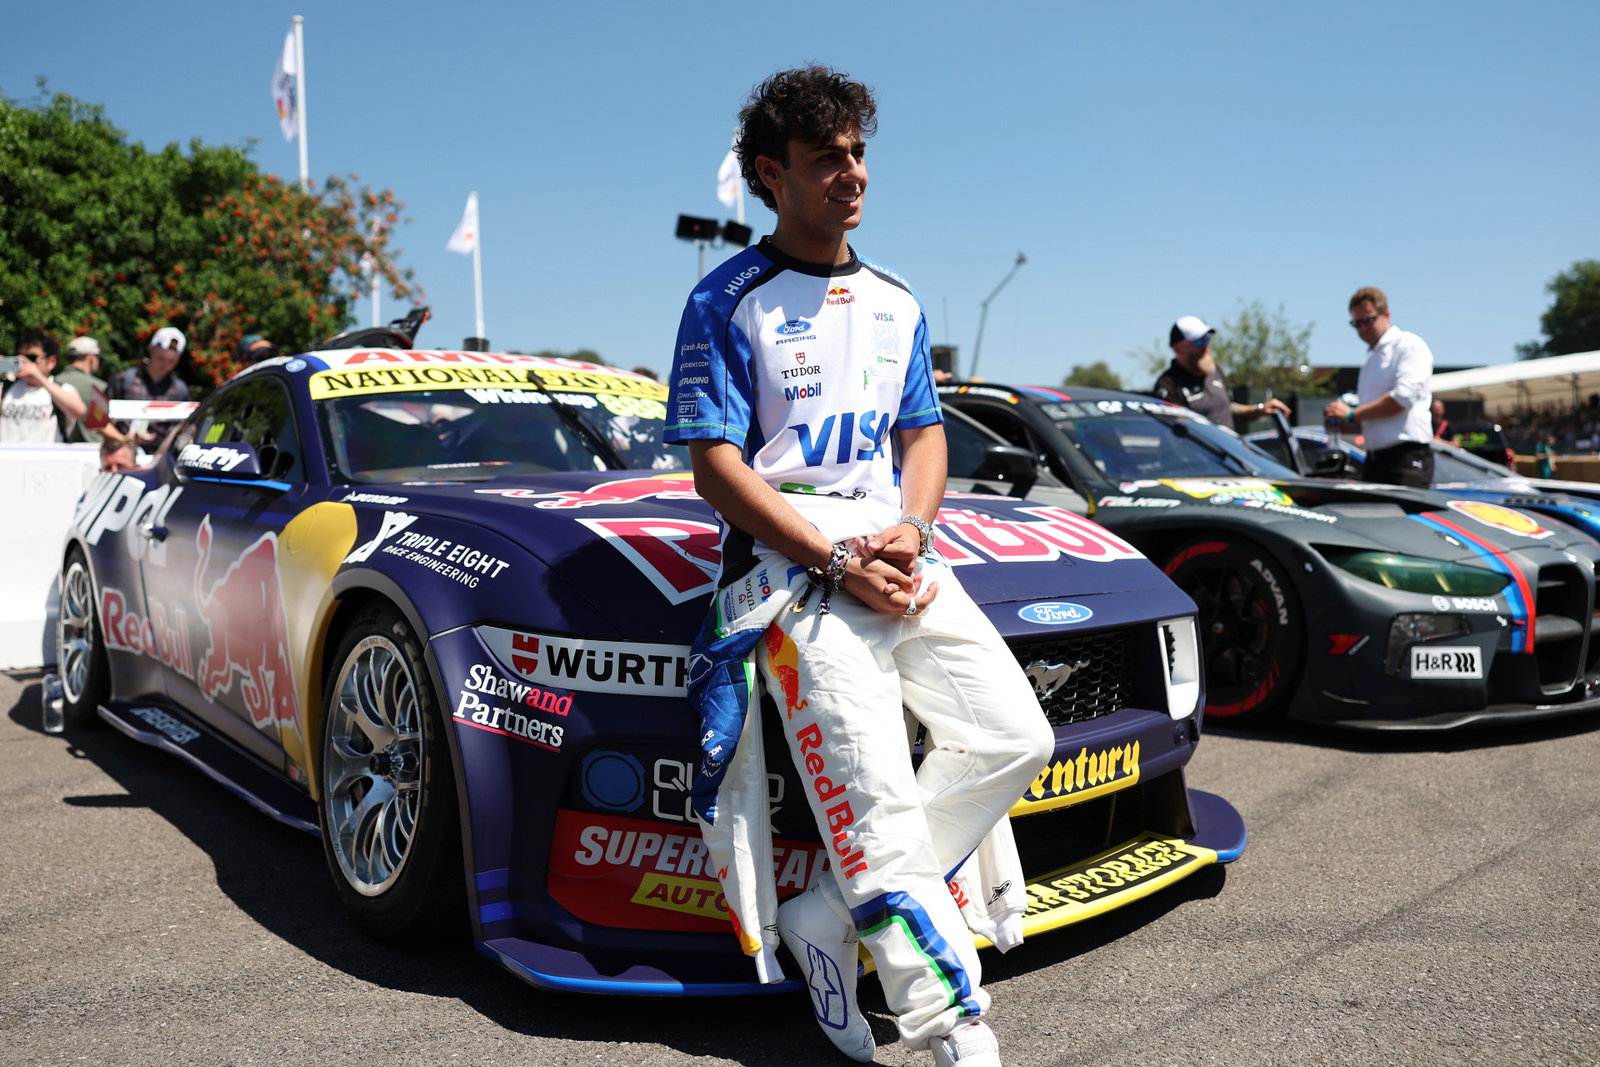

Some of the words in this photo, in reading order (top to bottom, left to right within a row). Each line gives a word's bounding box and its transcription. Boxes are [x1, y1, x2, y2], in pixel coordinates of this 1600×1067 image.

[724, 264, 761, 297] HUGO
[826, 297, 842, 306] Red
[841, 294, 855, 305] Bull
[873, 311, 895, 323] VISA
[696, 342, 709, 351] App
[775, 334, 817, 346] RACING
[322, 365, 530, 391] NATIONAL
[781, 365, 821, 379] TUDOR
[464, 388, 598, 408] Whinup
[784, 382, 822, 401] Mobil
[788, 410, 890, 467] VISA
[382, 545, 409, 557] RACE
[406, 551, 480, 589] ENGINEERING
[395, 531, 452, 556] TRIPLE
[446, 546, 510, 578] EIGHT
[1251, 559, 1289, 625] ADVAN
[1451, 598, 1499, 611] BOSCH
[1033, 604, 1081, 621] Ford
[101, 587, 159, 661] Red
[148, 596, 195, 681] Bull
[1415, 652, 1453, 672] H&R
[464, 664, 529, 703] Shaw
[453, 692, 564, 748] Partners
[1030, 739, 1140, 800] entury
[797, 722, 847, 804] Red
[826, 784, 868, 880] Bull
[646, 883, 729, 913] AUTO
